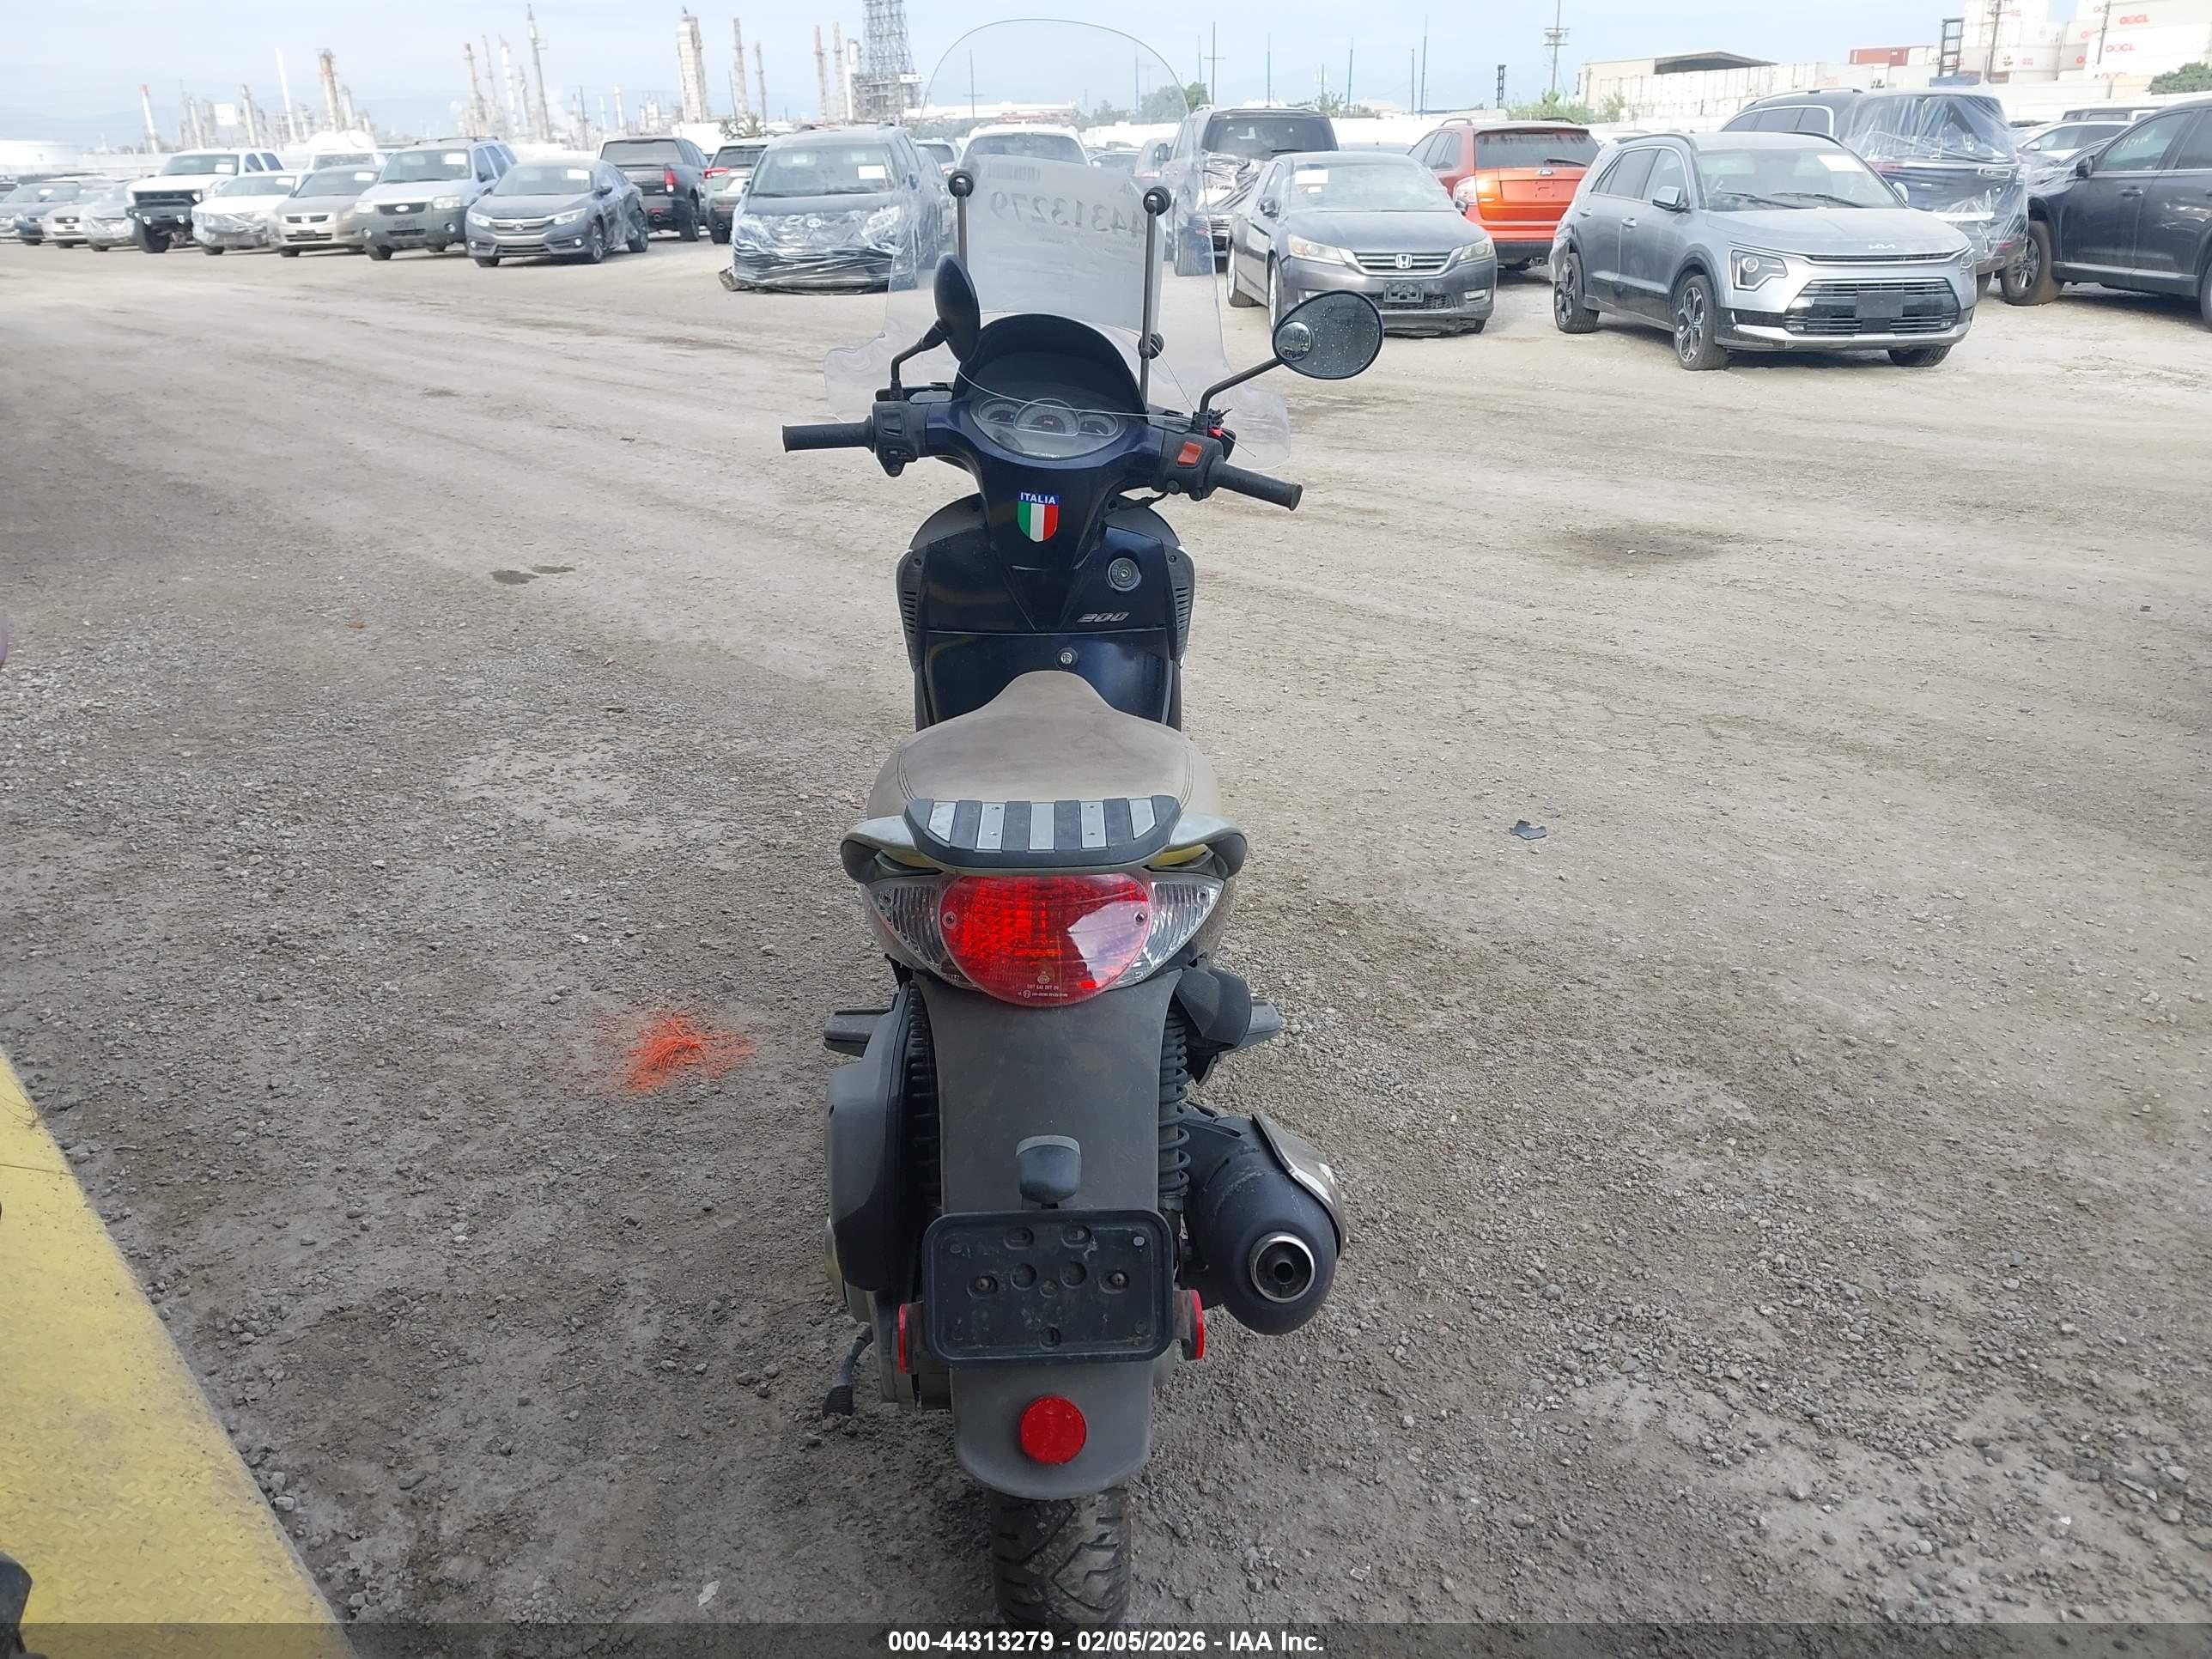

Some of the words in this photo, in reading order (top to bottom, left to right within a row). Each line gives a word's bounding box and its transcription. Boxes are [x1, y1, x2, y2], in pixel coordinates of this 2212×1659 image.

[2119, 14, 2150, 25] OOCL
[2106, 43, 2136, 53] OOCL
[1020, 492, 1056, 505] ITALIA
